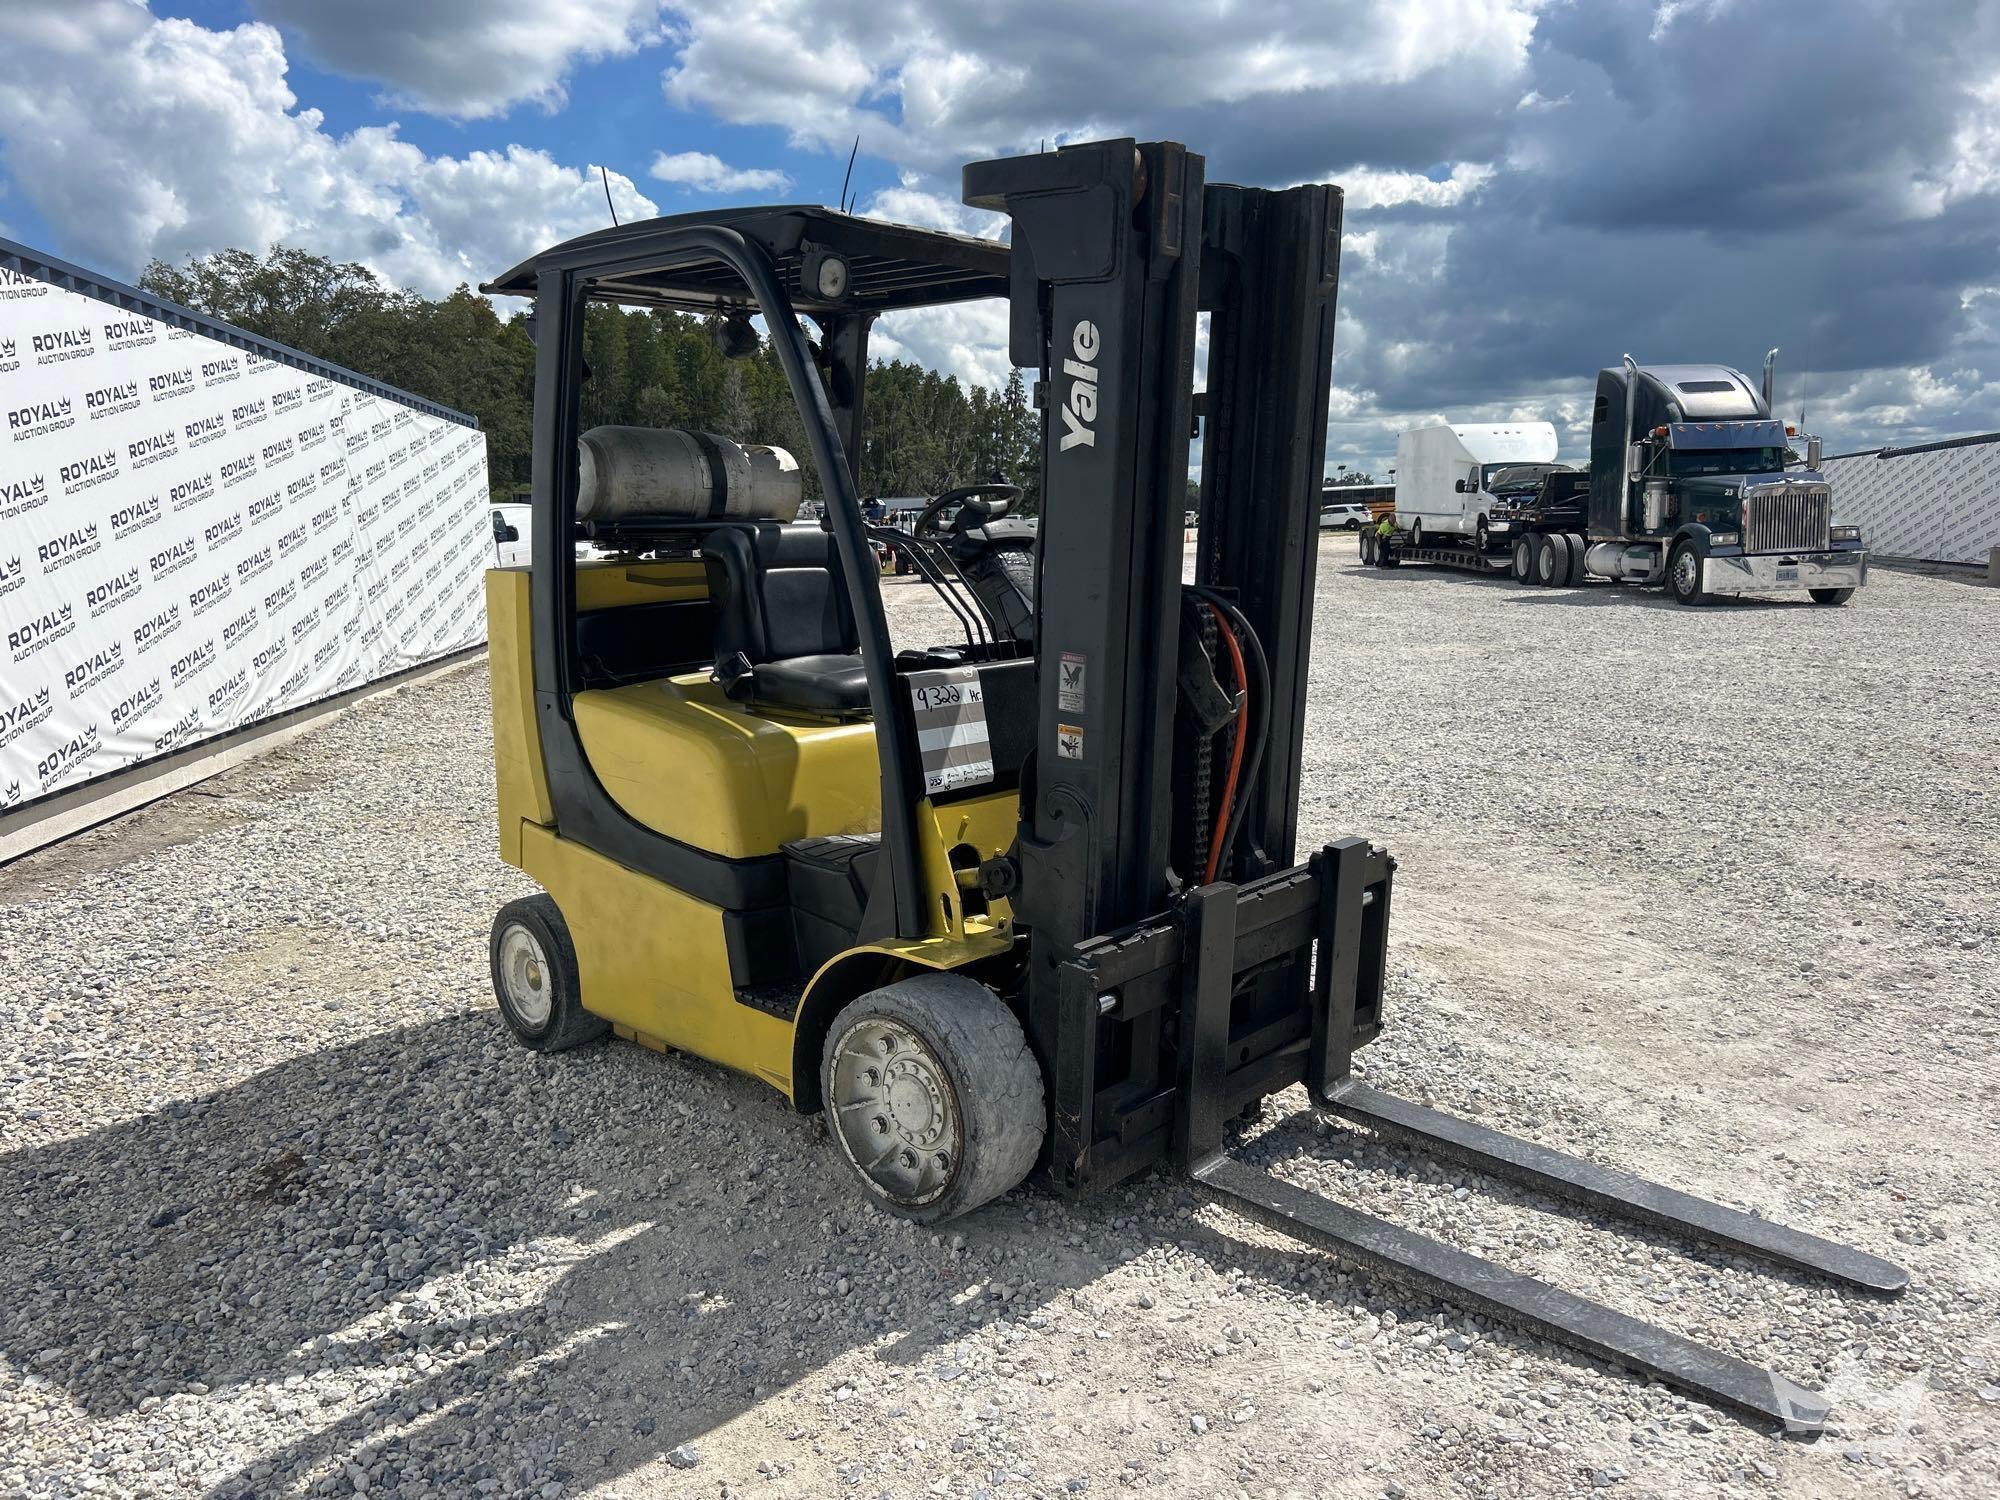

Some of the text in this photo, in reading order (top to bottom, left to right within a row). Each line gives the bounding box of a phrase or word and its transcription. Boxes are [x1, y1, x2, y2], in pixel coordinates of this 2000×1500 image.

[21, 287, 48, 297] GROUP
[33, 331, 80, 352] ROYAL
[104, 321, 144, 340] ROYAL
[109, 336, 156, 351] AUCTION GROUP
[37, 347, 95, 365] AUCTION GROUP
[202, 359, 232, 378] ROYAL
[149, 371, 185, 391] ROYAL
[153, 385, 195, 402] AUCTION GROUP
[1060, 320, 1100, 452] Yale
[85, 385, 128, 408] ROYAL
[91, 399, 141, 420] AUCTION GROUP
[8, 402, 60, 429] ROYAL
[185, 417, 217, 438] ROYAL
[13, 418, 75, 442] AUCTION GROUP
[129, 435, 167, 459] ROYAL
[133, 447, 178, 470] AUCTION GROUP
[60, 455, 106, 483] ROYAL
[65, 469, 119, 496] AUCTION GROUP
[21, 495, 48, 512] GROUP
[170, 478, 205, 502] ROYAL
[1724, 488, 1733, 496] 23
[111, 501, 150, 529] ROYAL
[115, 512, 161, 541] AUCTION GROUP
[205, 517, 234, 542] ROYAL
[38, 530, 87, 562] ROYAL
[43, 541, 101, 575] AUCTION GROUP
[150, 543, 186, 571] ROYAL
[154, 553, 197, 582] AUCTION GROUP
[87, 574, 130, 607] ROYAL
[91, 584, 142, 619] AUCTION GROUP
[190, 579, 223, 607] ROYAL
[8, 612, 60, 651] ROYAL
[134, 612, 170, 645] ROYAL
[138, 621, 181, 655] AUCTION GROUP
[13, 622, 76, 664] AUCTION GROUP
[252, 641, 281, 669] ROYAL
[65, 650, 111, 689] ROYAL
[170, 647, 206, 680] ROYAL
[70, 659, 124, 700] AUCTION GROUP
[209, 676, 239, 708] ROYAL
[111, 687, 151, 724] ROYAL
[917, 685, 960, 713] 9,322
[26, 706, 53, 731] GROUP
[115, 693, 162, 736] AUCTION GROUP
[155, 717, 193, 752] ROYAL
[38, 735, 88, 779] ROYAL
[42, 741, 102, 793] AUCTION GROUP
